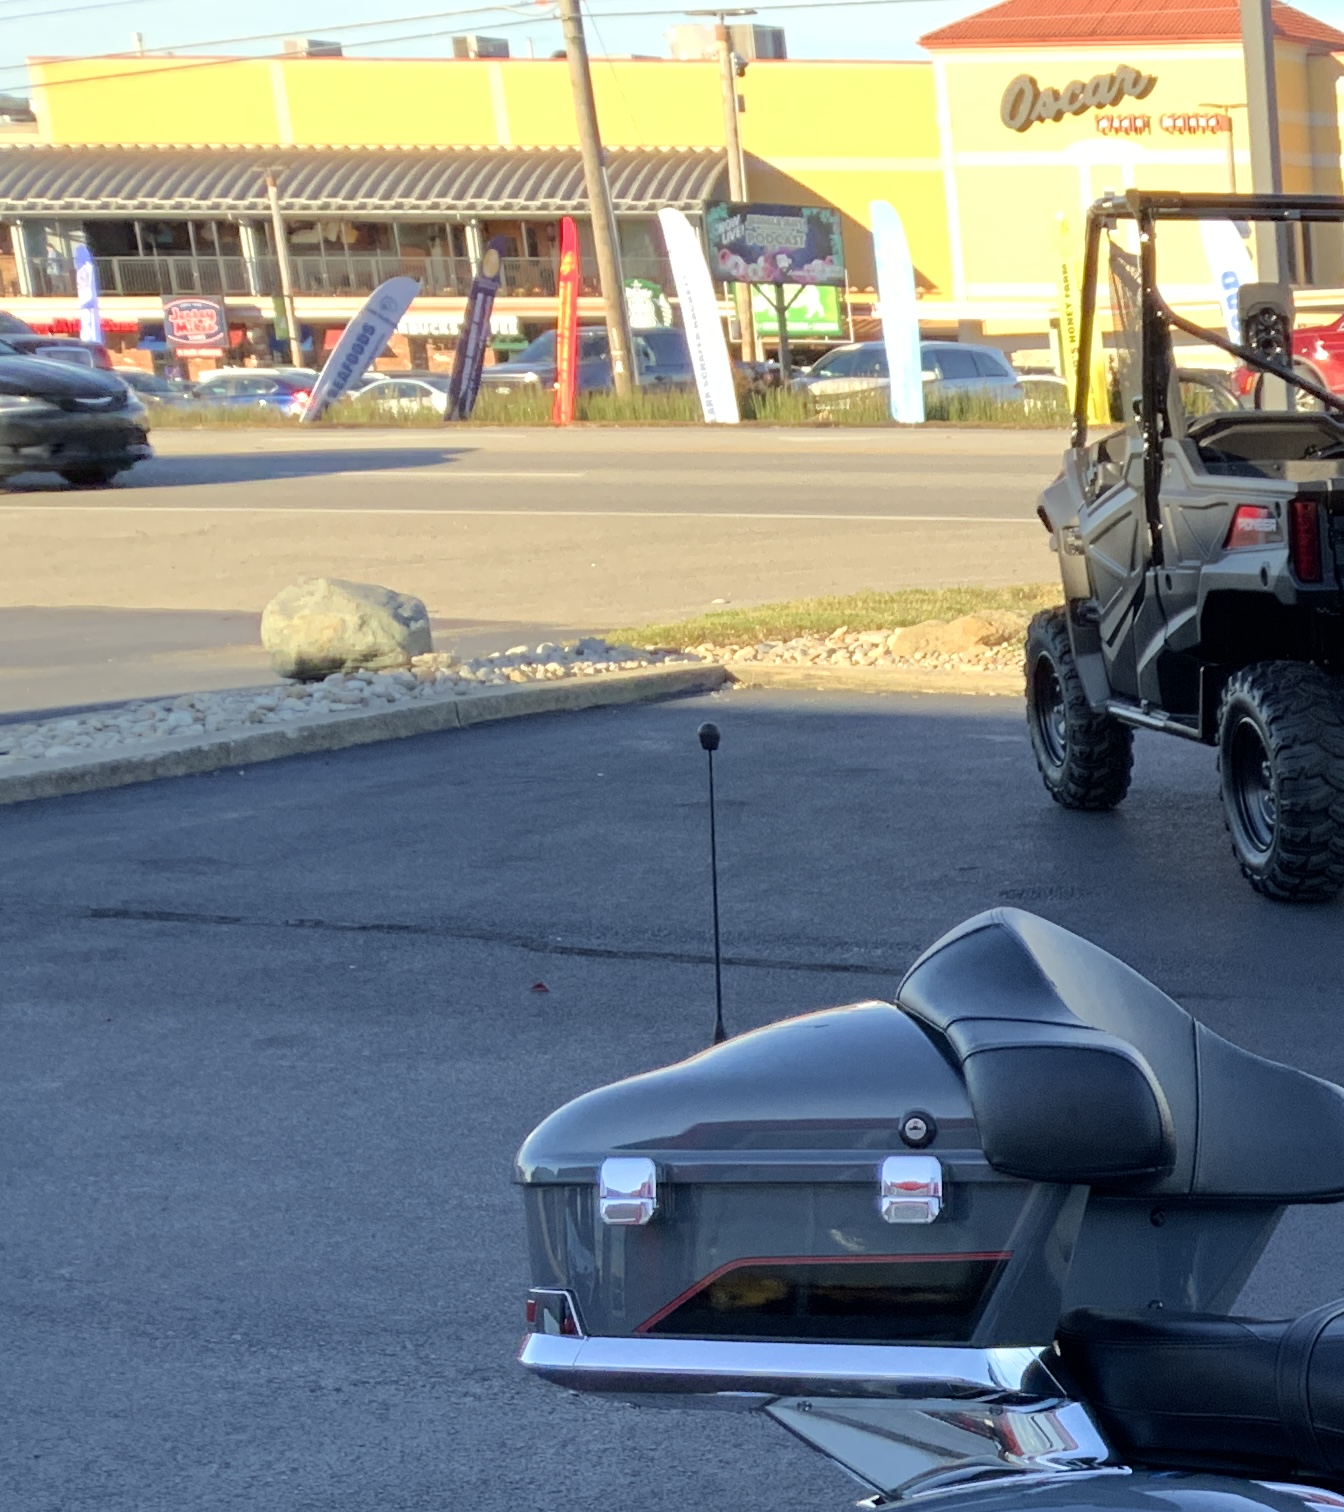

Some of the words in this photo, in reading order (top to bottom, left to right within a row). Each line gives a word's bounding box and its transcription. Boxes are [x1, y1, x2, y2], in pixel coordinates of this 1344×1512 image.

[1000, 63, 1158, 133] Oscar
[720, 214, 741, 232] NOW
[722, 224, 745, 244] LIVE!
[745, 230, 807, 248] PODCAST
[1065, 303, 1076, 343] HONEY
